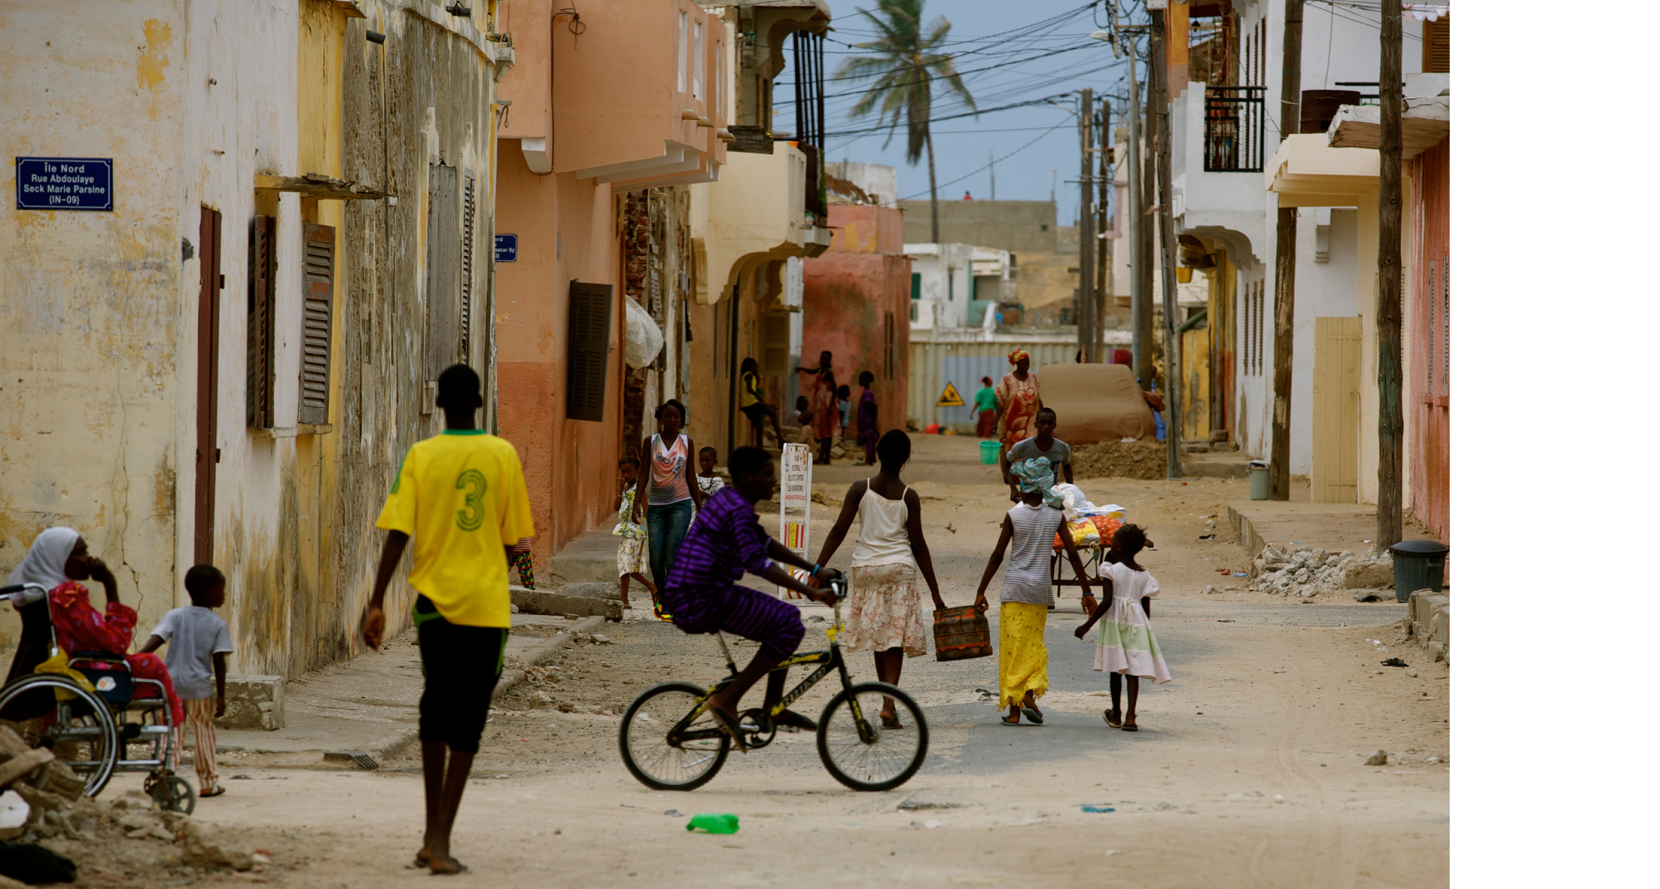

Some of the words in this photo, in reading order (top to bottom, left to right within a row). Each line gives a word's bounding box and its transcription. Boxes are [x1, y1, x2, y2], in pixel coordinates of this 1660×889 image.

[44, 162, 57, 172] Île
[61, 164, 85, 173] Nord
[31, 174, 48, 183] Rue
[50, 175, 94, 185] Abdoulaye
[23, 184, 44, 193] Seck
[47, 185, 71, 193] Marie
[73, 185, 105, 194] Parsine
[49, 195, 80, 205] (IN-09)
[455, 468, 488, 532] 3
